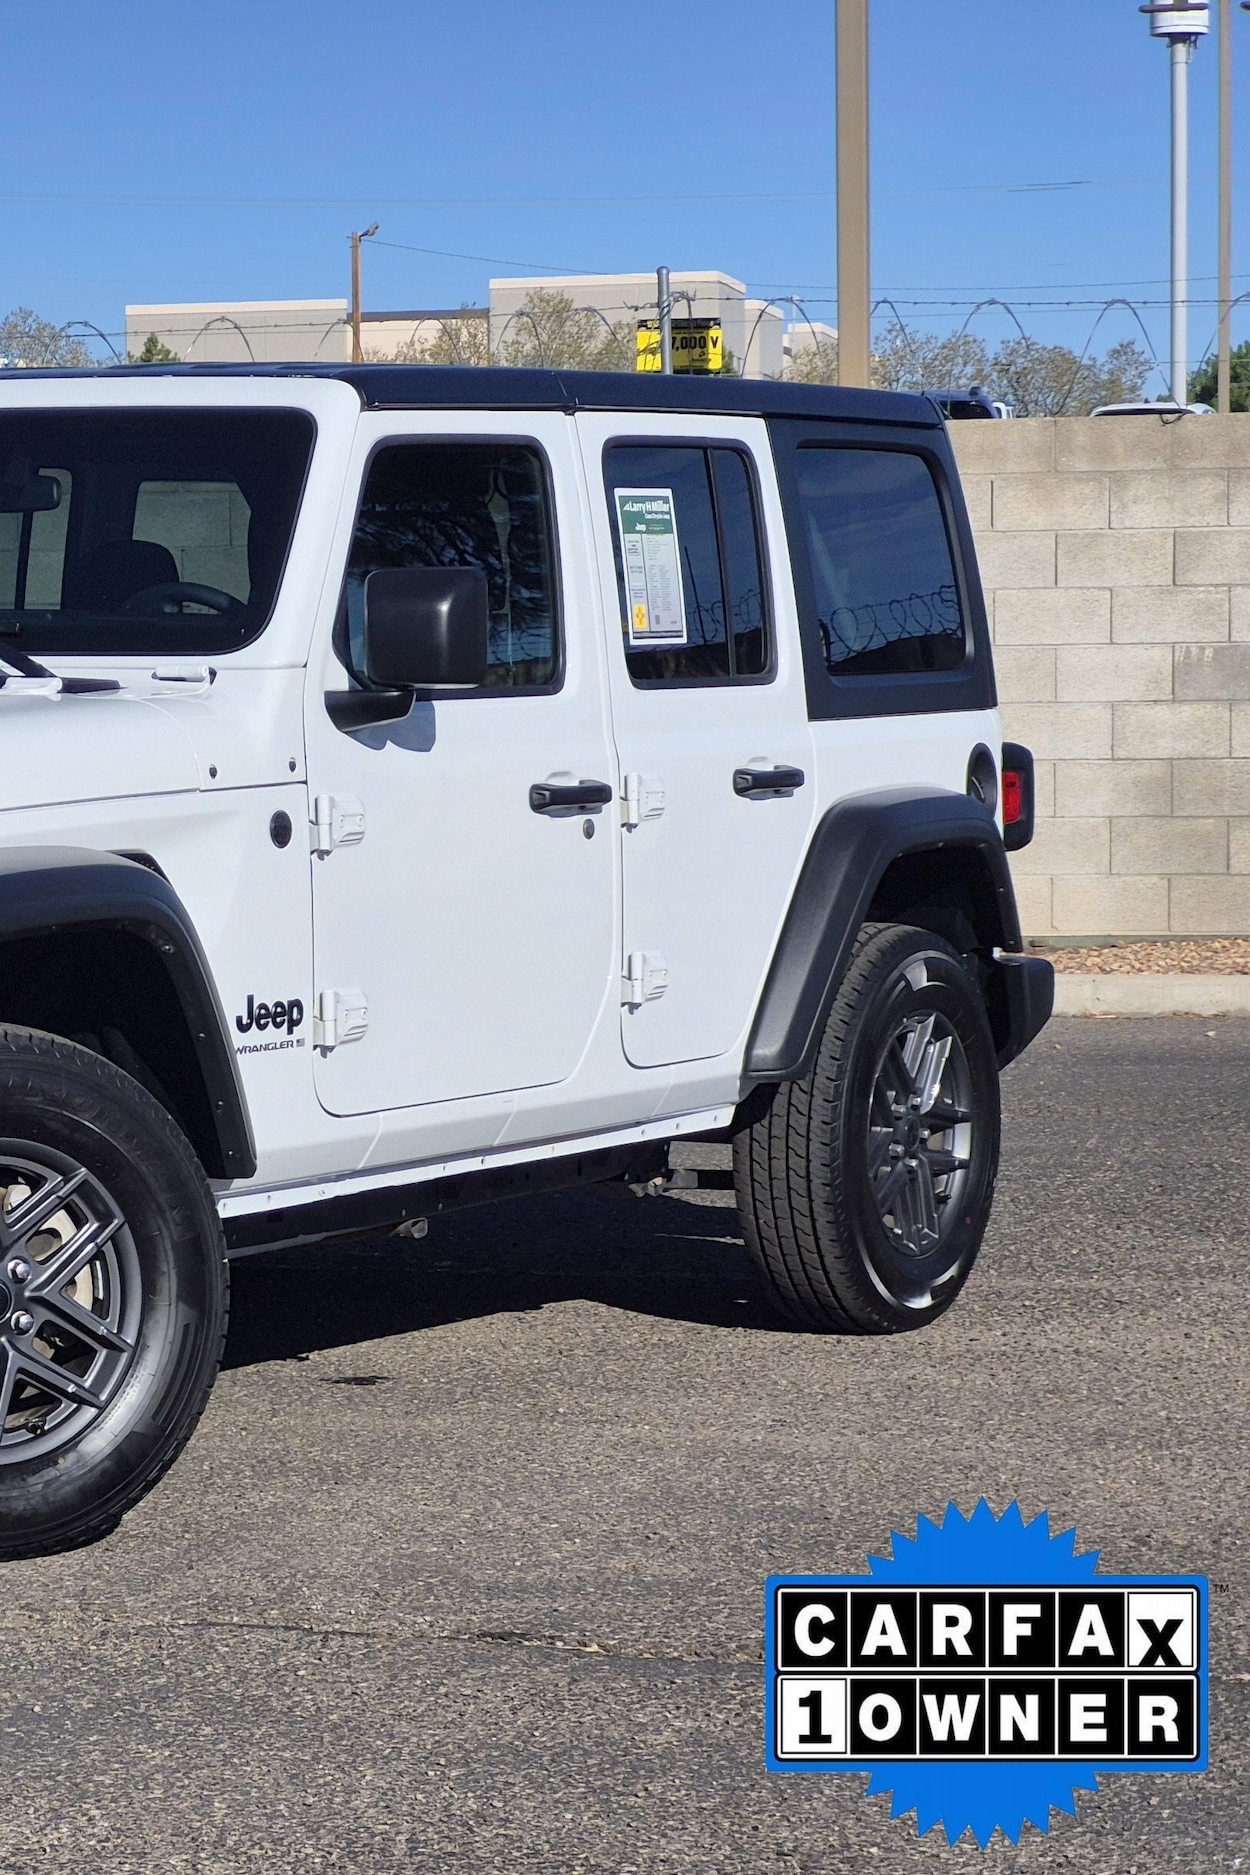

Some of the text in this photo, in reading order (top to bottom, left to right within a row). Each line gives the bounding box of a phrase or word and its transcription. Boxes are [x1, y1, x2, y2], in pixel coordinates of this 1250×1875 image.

[629, 500, 646, 514] Larry
[652, 500, 669, 512] Miller
[235, 994, 304, 1036] Jeep
[235, 1039, 294, 1055] WRANGLER
